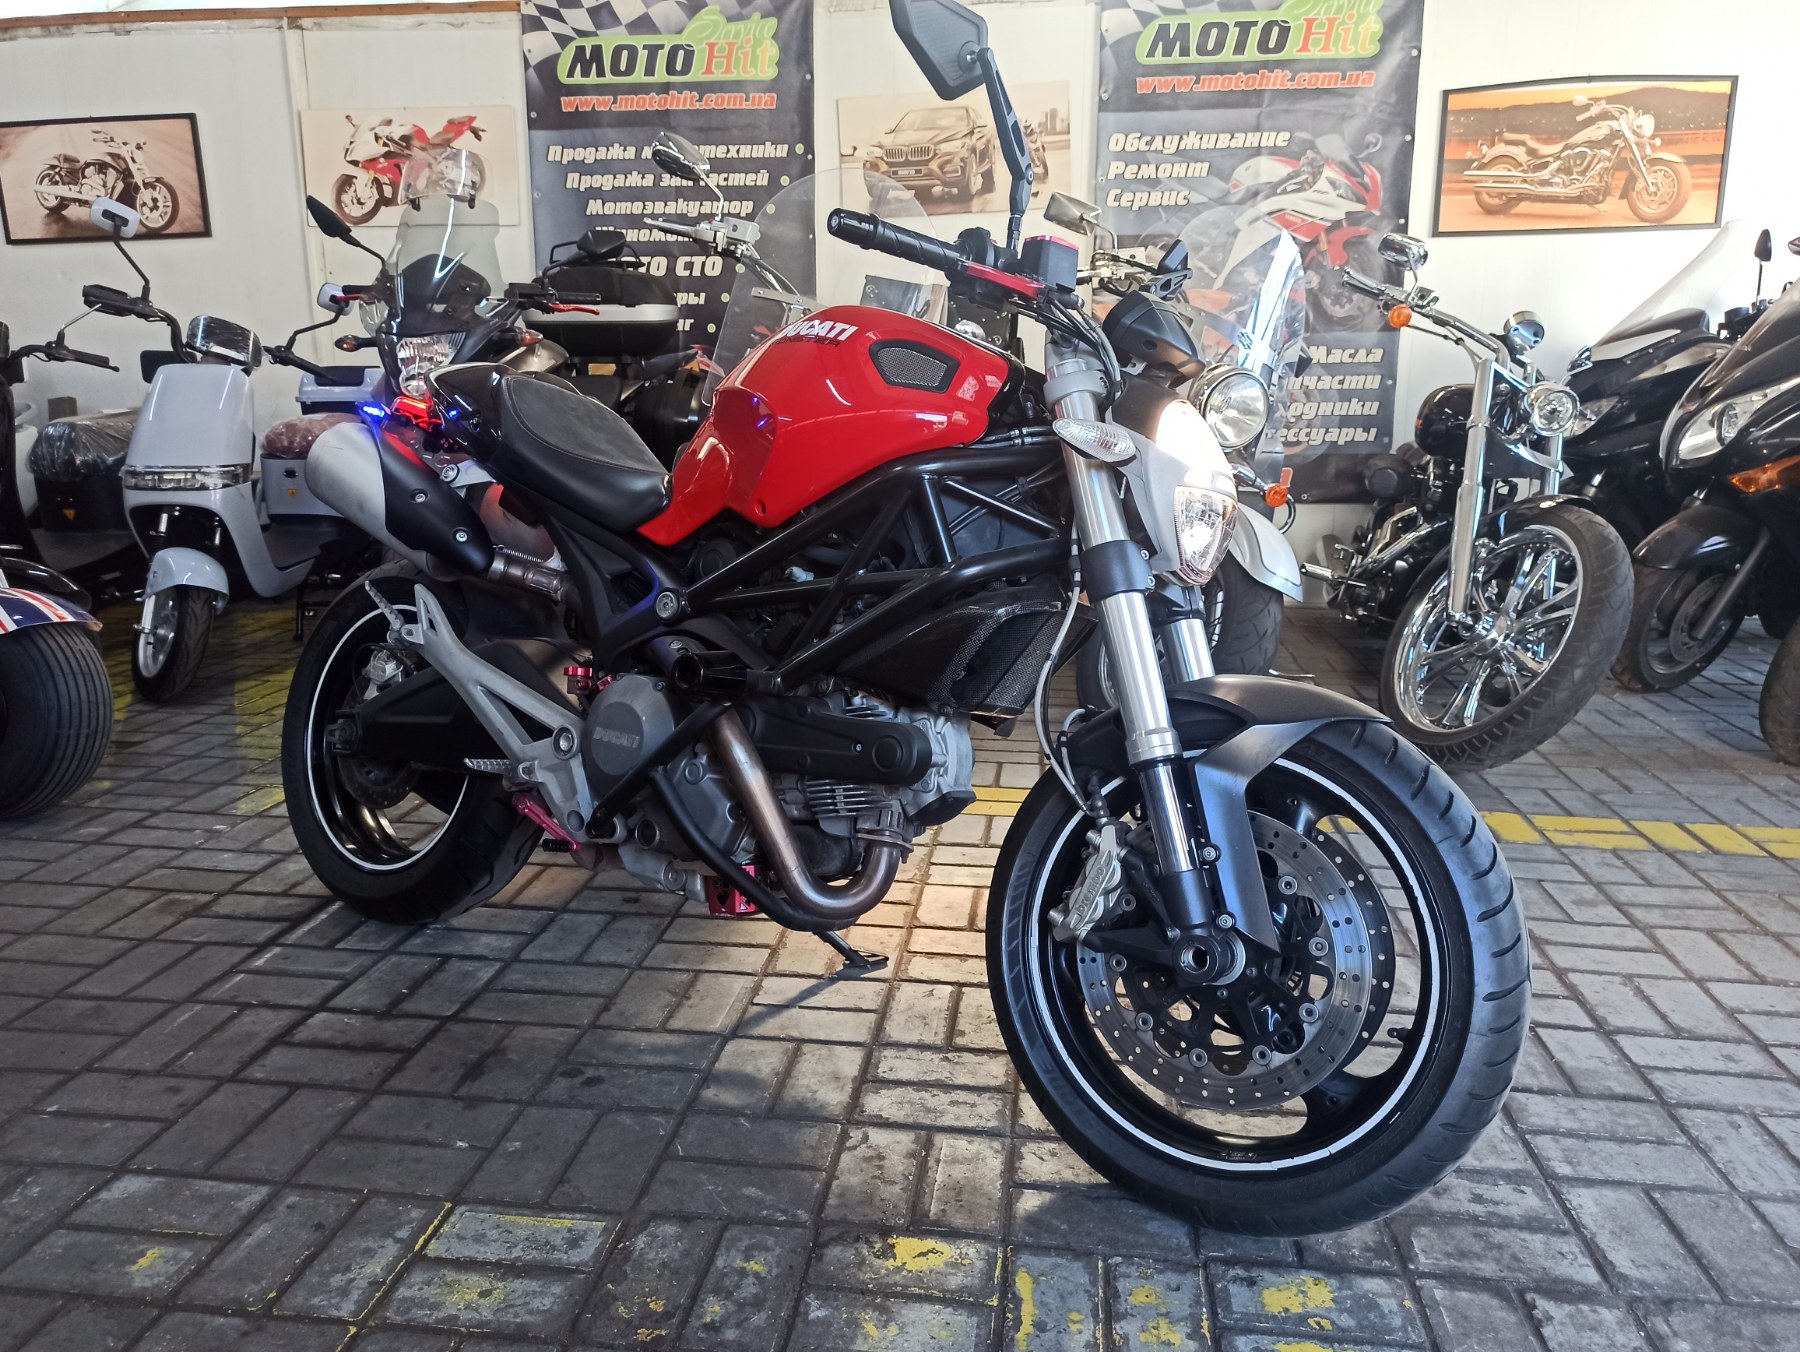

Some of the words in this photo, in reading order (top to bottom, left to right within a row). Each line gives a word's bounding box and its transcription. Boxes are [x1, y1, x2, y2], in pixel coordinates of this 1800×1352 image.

[1145, 18, 1293, 59] MOTO
[1295, 12, 1379, 55] Hit
[565, 42, 697, 80] MOTO
[700, 37, 777, 78] Hit
[1136, 69, 1376, 94] www.motohit.com.ua
[561, 91, 777, 112] www.motohit.com.ua
[1108, 130, 1291, 155] Обслуживание
[547, 143, 636, 165] Продажа
[565, 170, 655, 192] Продажа
[1107, 160, 1210, 180] Ремонт
[1106, 188, 1190, 211] Сервис
[675, 255, 723, 277] СТО
